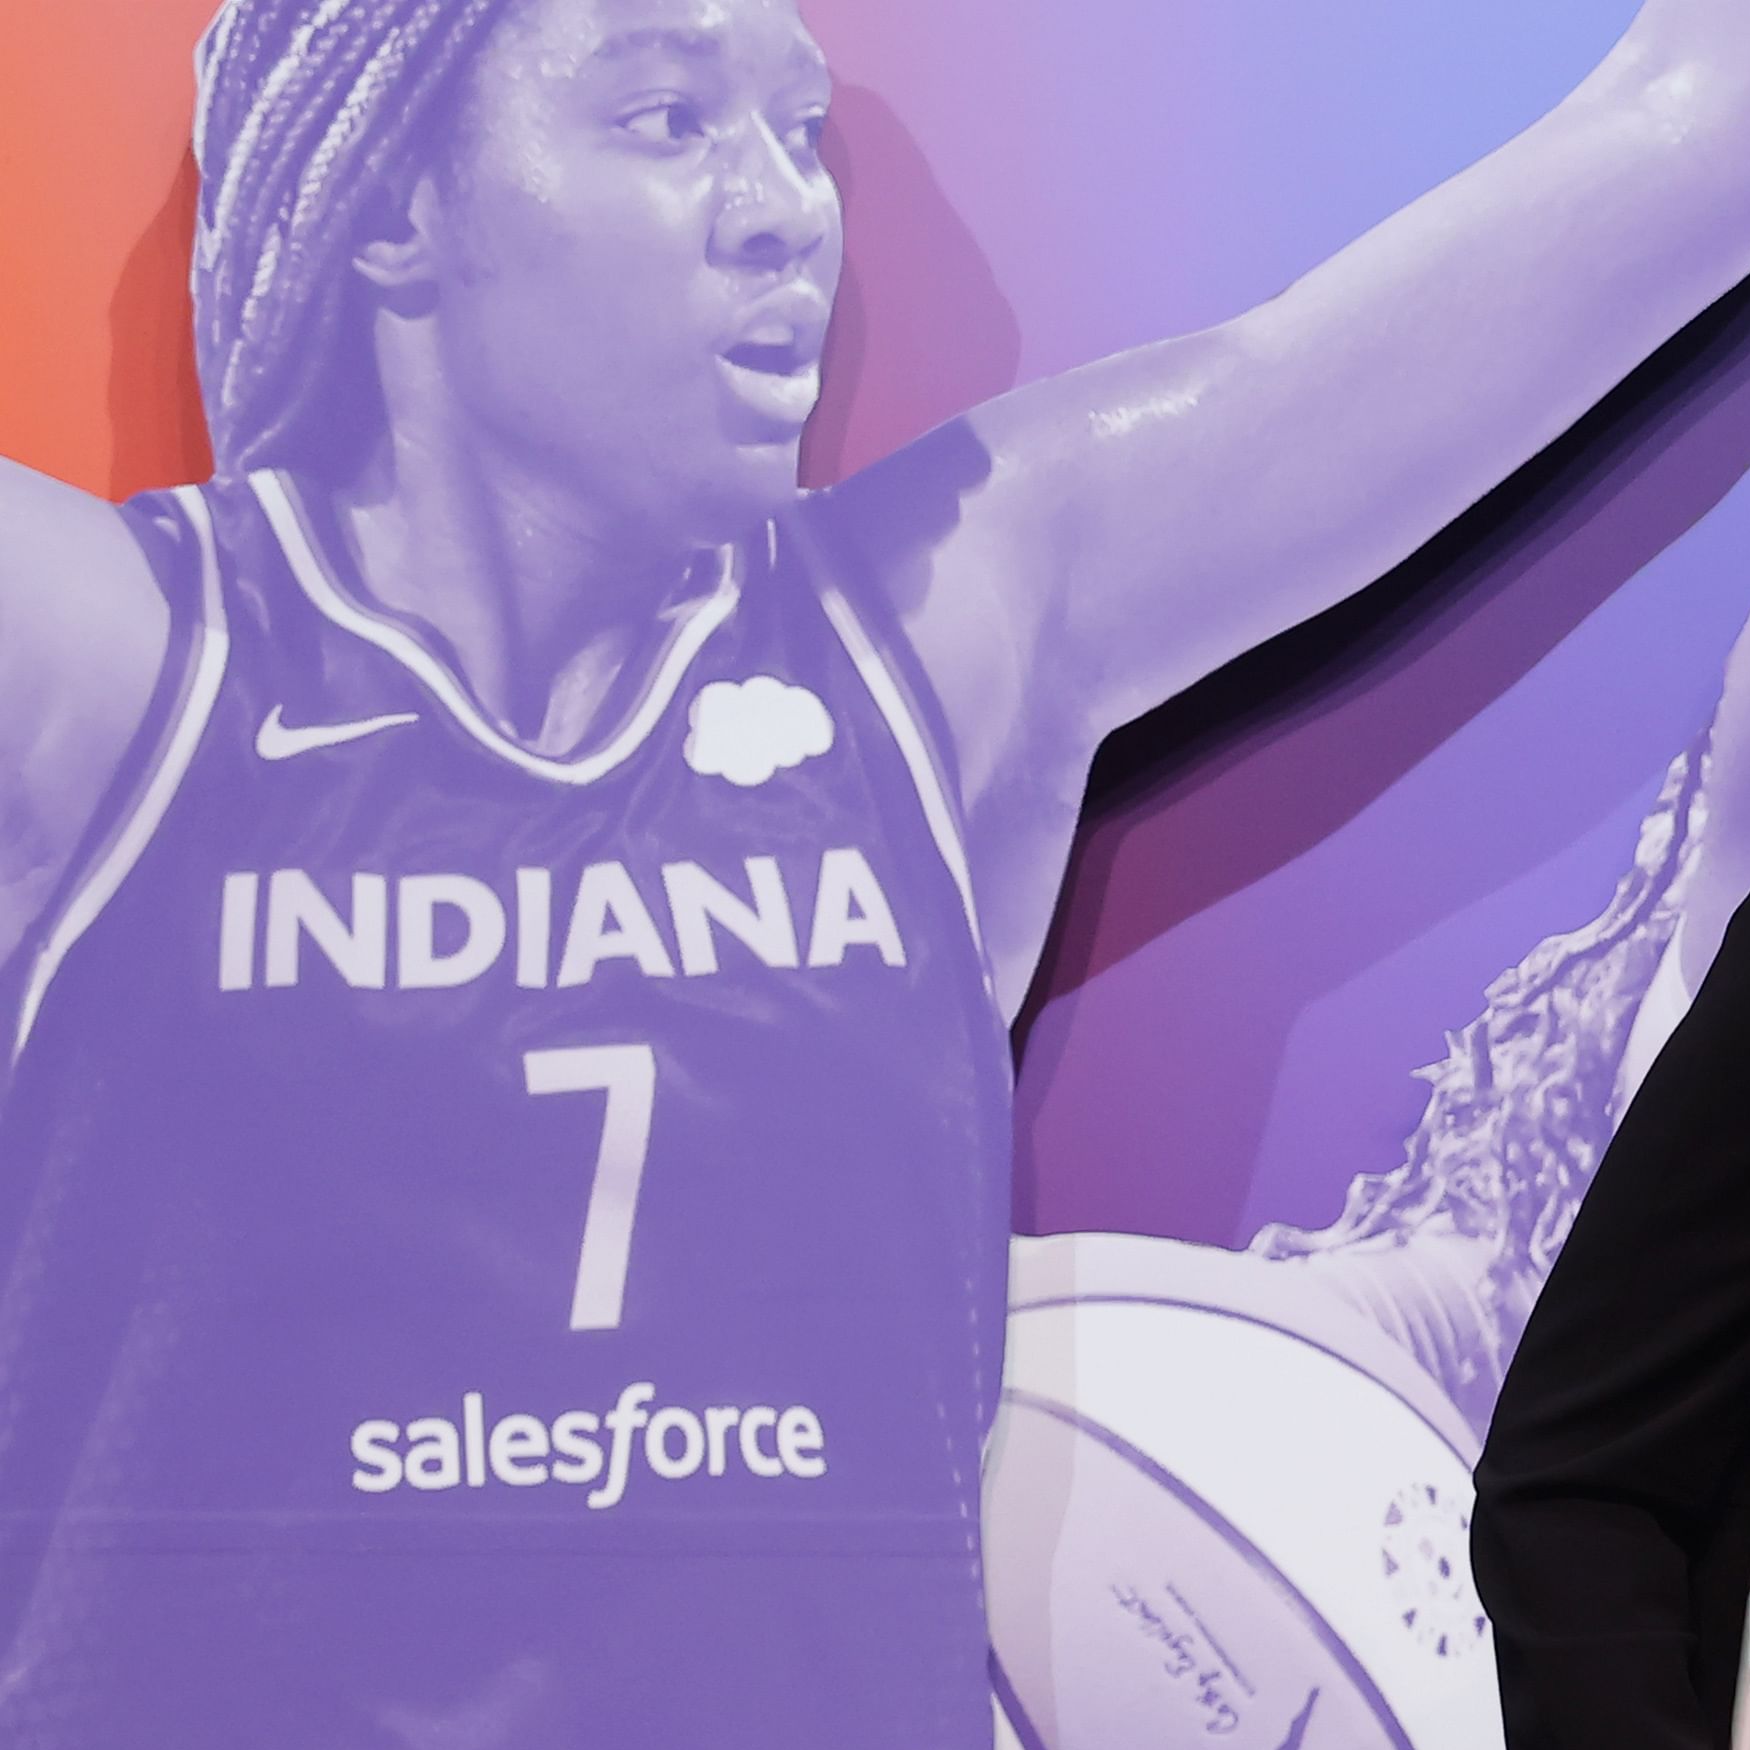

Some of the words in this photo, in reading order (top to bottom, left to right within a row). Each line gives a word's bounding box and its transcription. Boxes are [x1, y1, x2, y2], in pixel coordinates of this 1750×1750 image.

[219, 849, 906, 991] INDIANA
[522, 1044, 655, 1331] 7
[350, 1382, 827, 1508] salesforce
